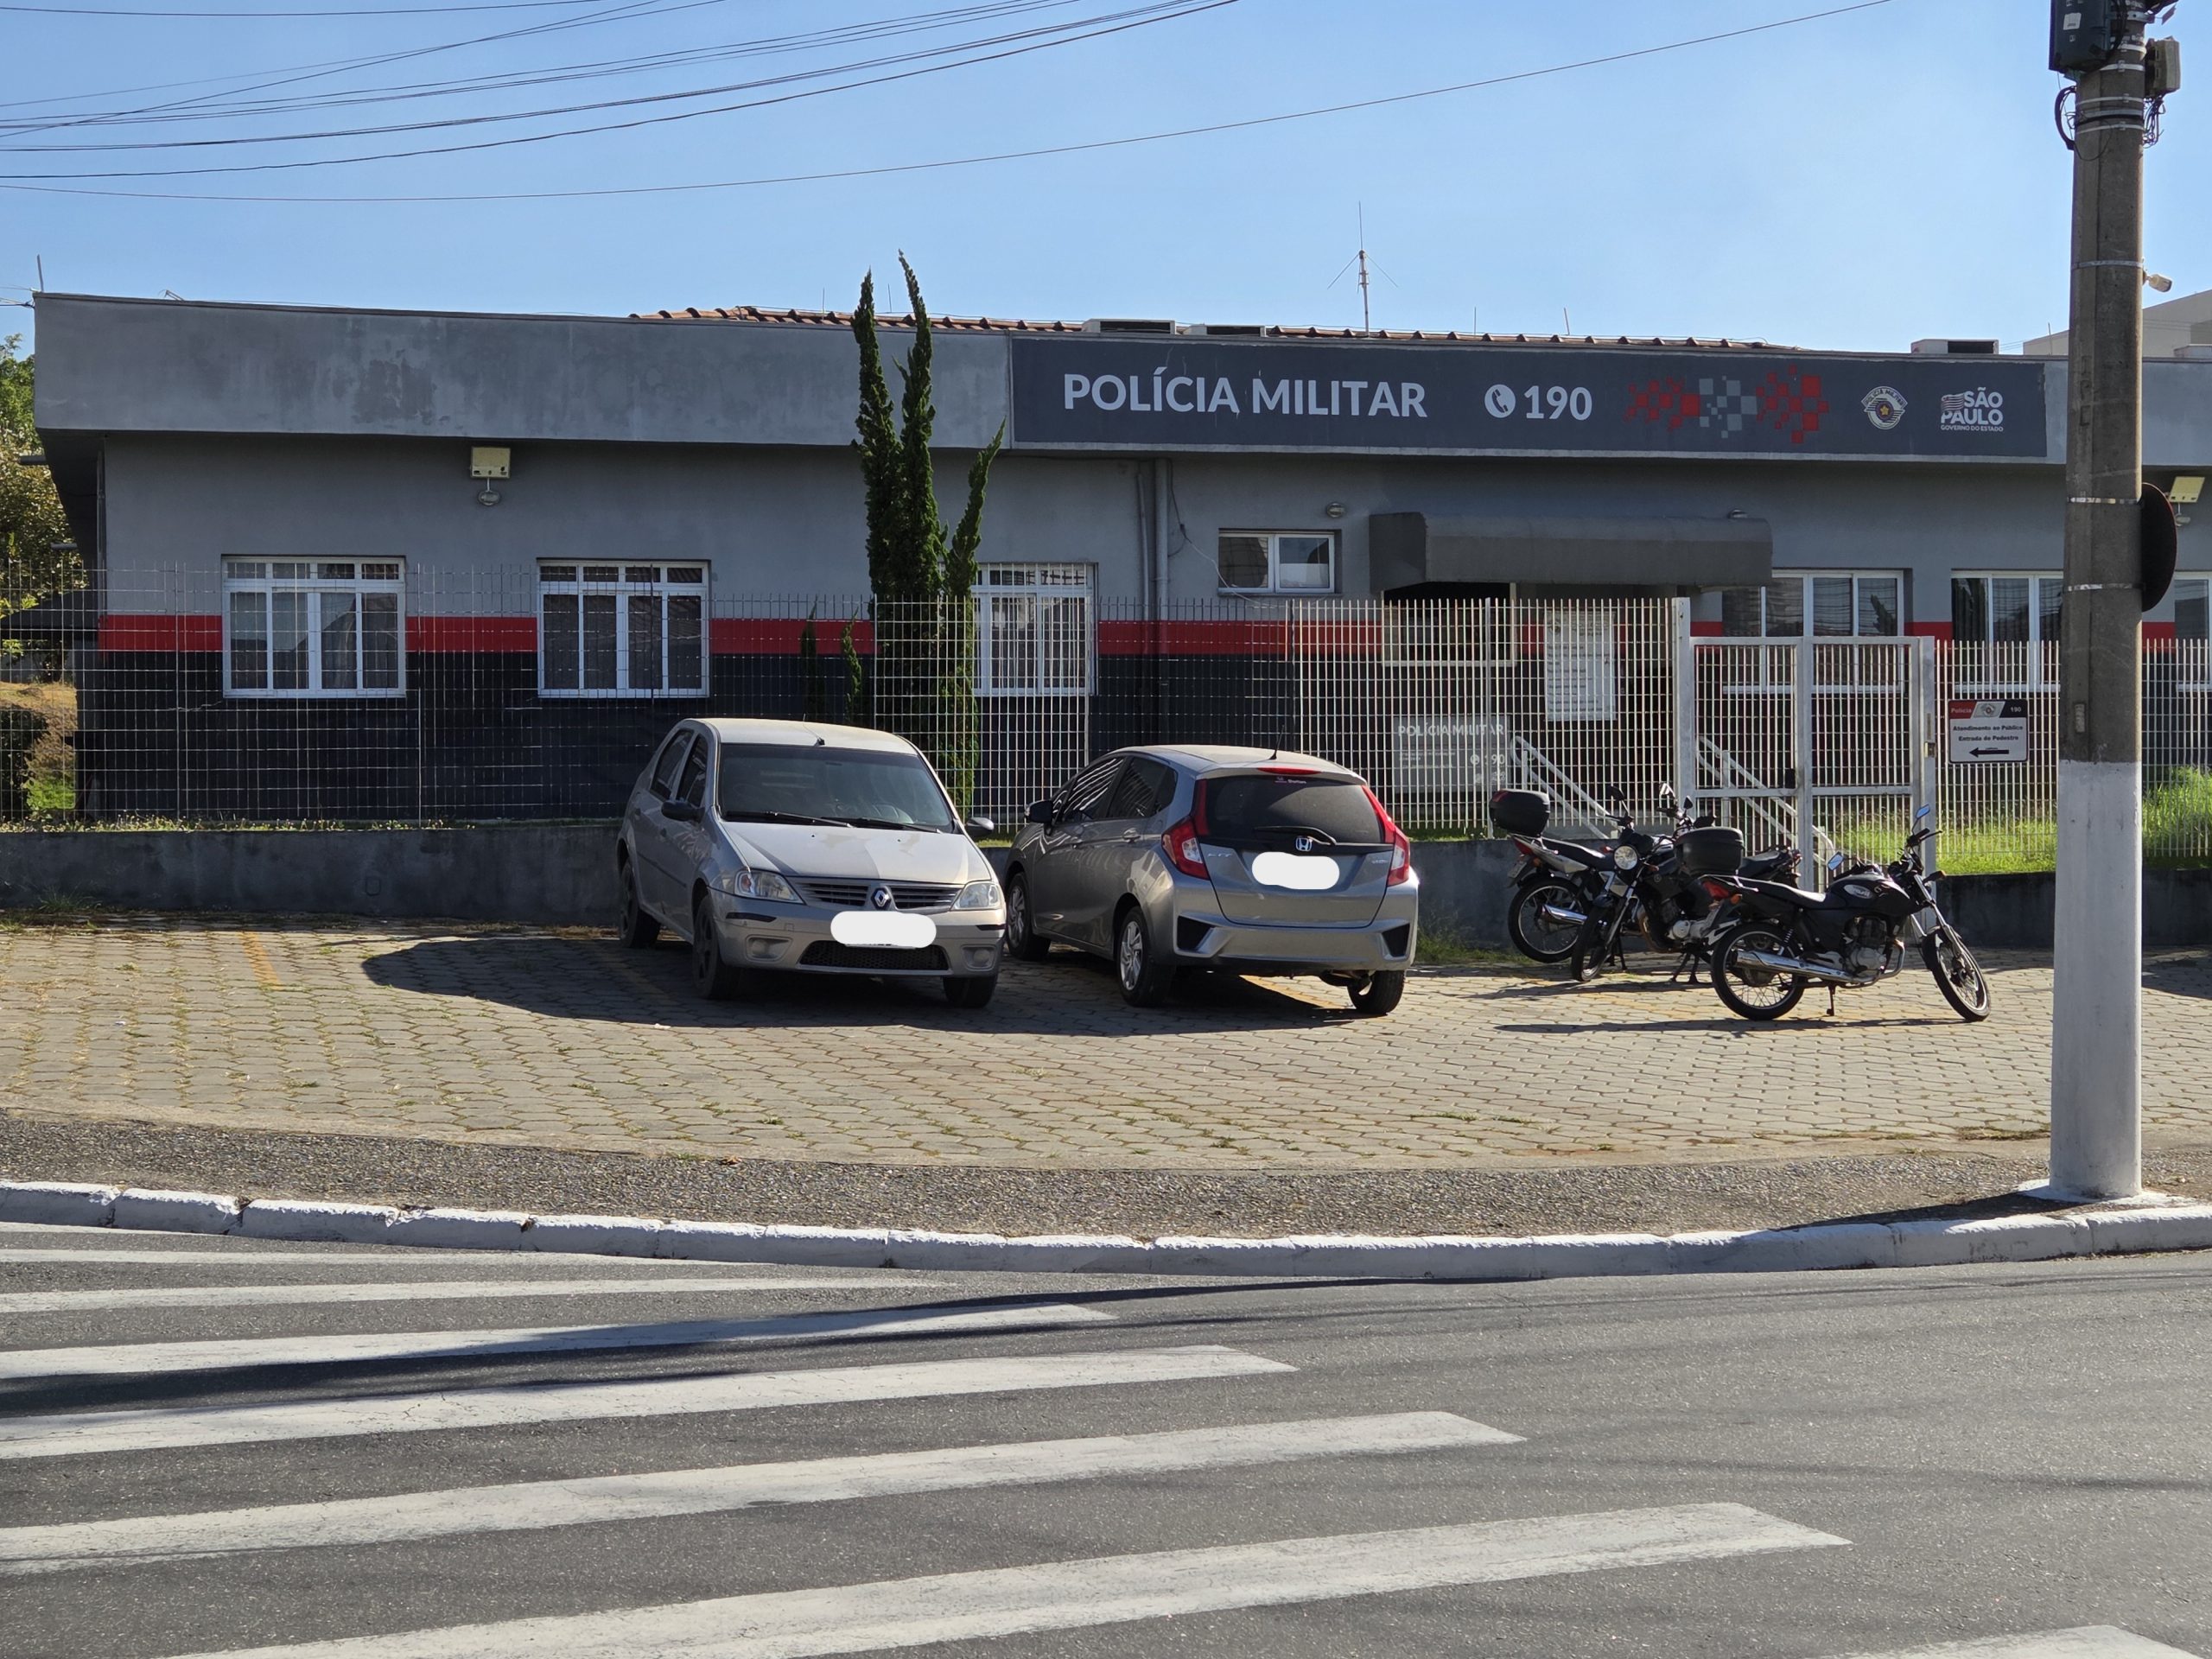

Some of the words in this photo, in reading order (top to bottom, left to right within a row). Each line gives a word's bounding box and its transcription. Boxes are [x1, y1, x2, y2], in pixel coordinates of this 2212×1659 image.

[1064, 366, 1241, 413] POLÍCIA
[1252, 378, 1428, 417] MILITAR
[1523, 385, 1592, 421] 190
[1963, 386, 2004, 409] SÃO
[1941, 408, 2004, 426] PAULO
